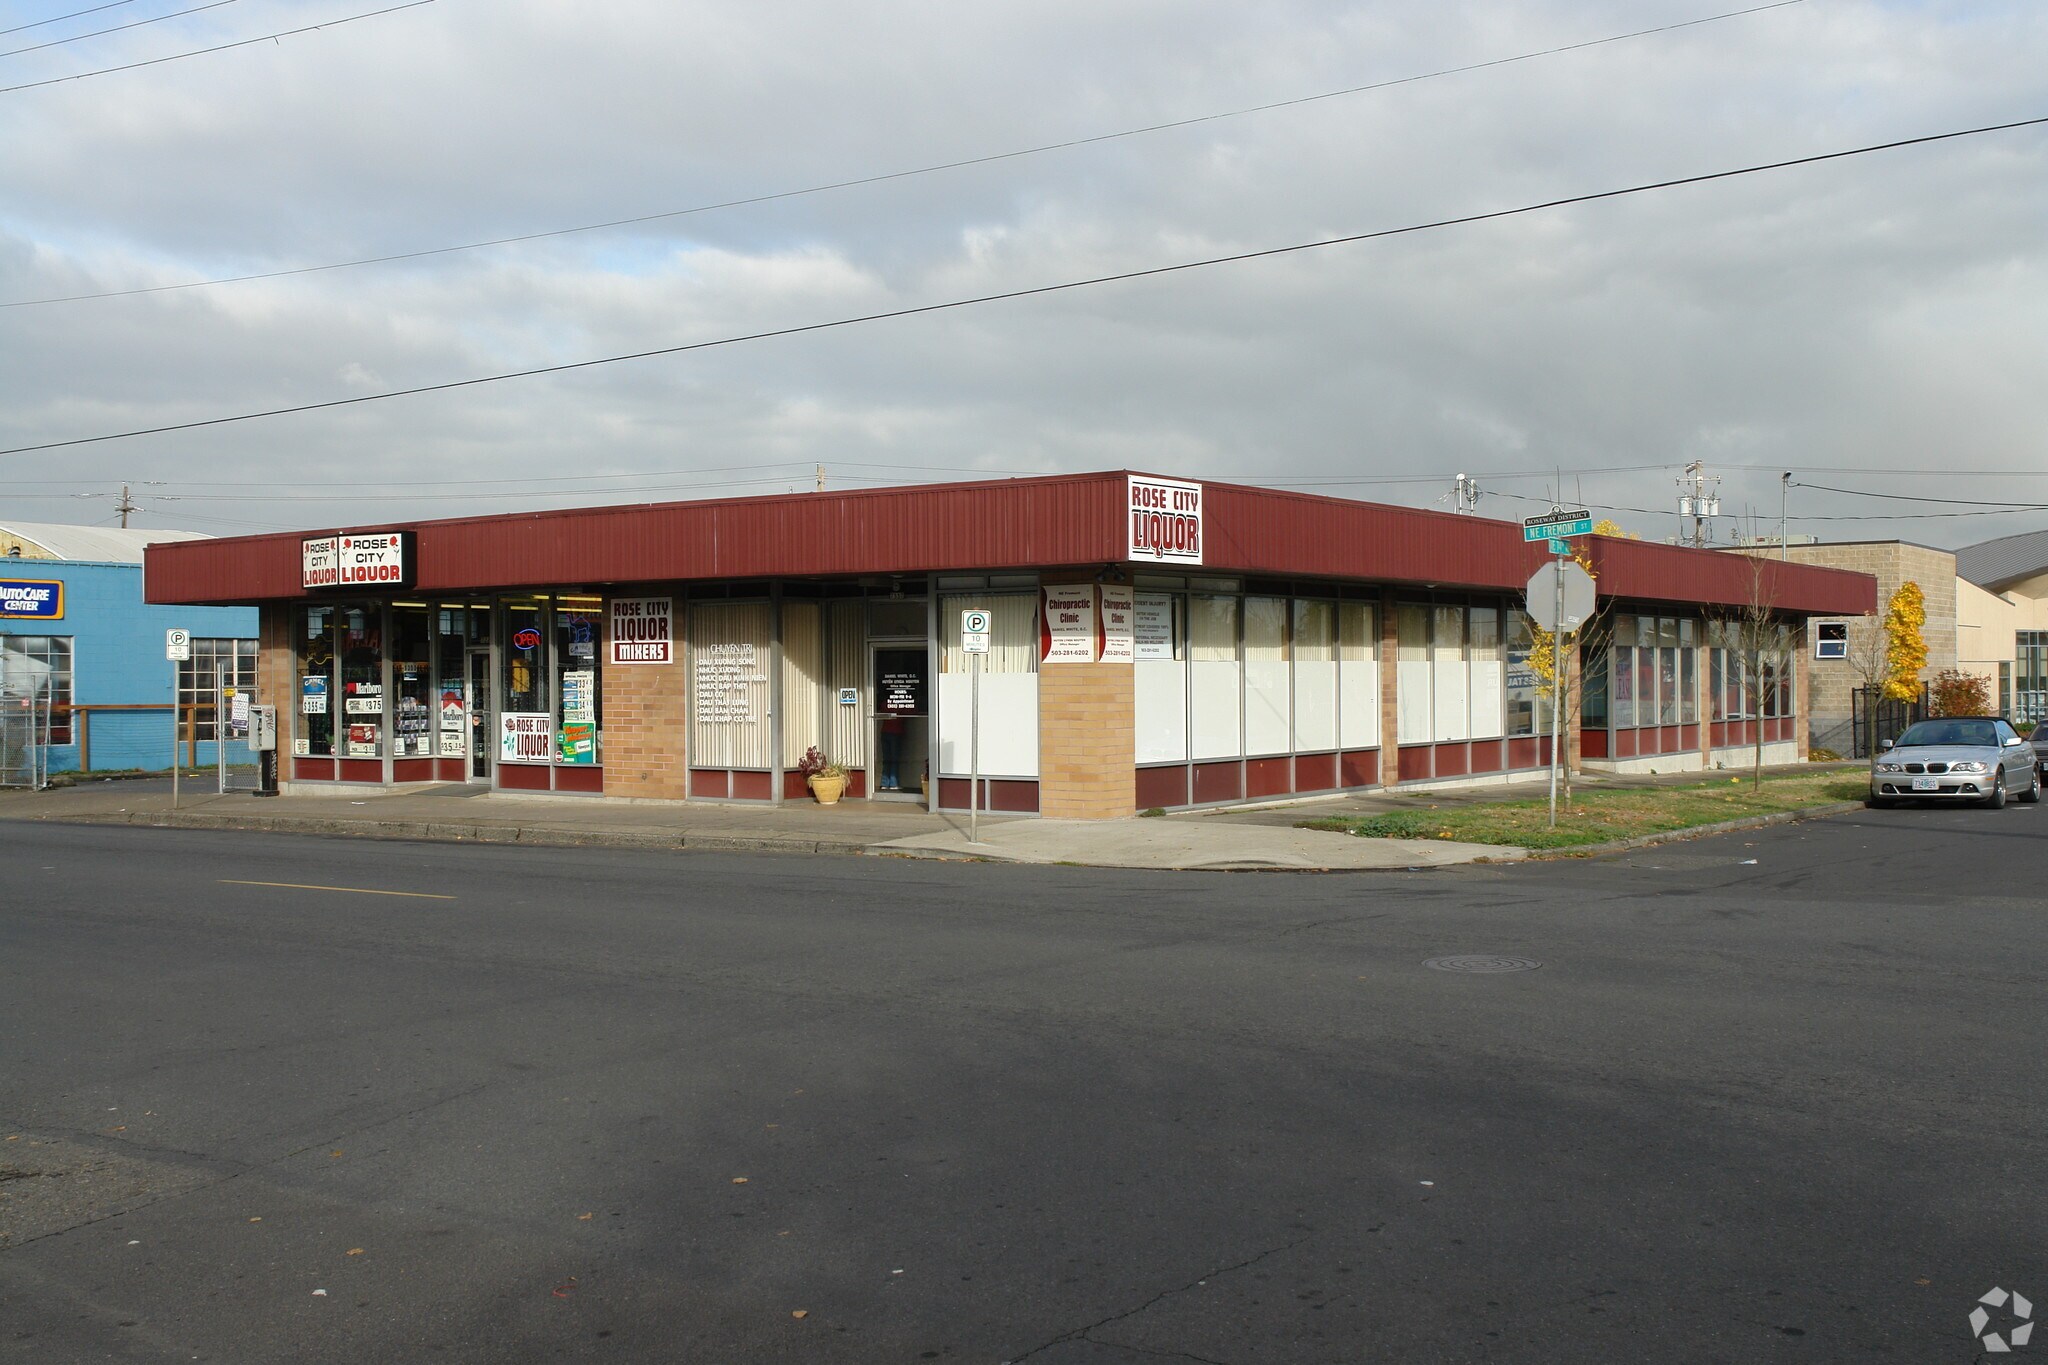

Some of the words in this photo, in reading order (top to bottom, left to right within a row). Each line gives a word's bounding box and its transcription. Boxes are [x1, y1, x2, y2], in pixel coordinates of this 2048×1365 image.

[1132, 486, 1166, 509] ROSE
[1174, 490, 1198, 512] CITY
[1526, 516, 1557, 526] ROSEWAY
[1558, 512, 1588, 520] DISTRICT
[1132, 510, 1199, 558] LIQUOR
[1530, 528, 1540, 538] NE
[1542, 522, 1577, 537] FREMONT
[310, 543, 330, 554] ROSE
[354, 539, 388, 550] ROSE
[312, 556, 328, 566] CITY
[356, 552, 384, 563] CITY
[304, 568, 336, 586] LIQUOR
[342, 565, 400, 582] LIQUOR
[4, 601, 38, 611] CENTER
[614, 602, 641, 616] ROSE
[646, 602, 668, 616] CITY
[1048, 598, 1090, 610] Chiropractic
[1104, 599, 1132, 610] Chiropractic
[972, 618, 982, 628] P
[1060, 613, 1080, 623] Clinic
[1112, 613, 1125, 624] Clinic
[614, 618, 668, 642] LIQUOR
[174, 634, 183, 642] P
[514, 633, 540, 646] OPEN
[619, 644, 664, 660] MIXERS
[304, 678, 324, 686] CAMEL
[356, 682, 382, 694] Marlboro
[841, 690, 856, 699] OPEN
[443, 712, 463, 721] Marlboro
[516, 719, 534, 732] ROSE
[536, 719, 549, 730] CITY
[516, 734, 549, 759] LIQUOR
